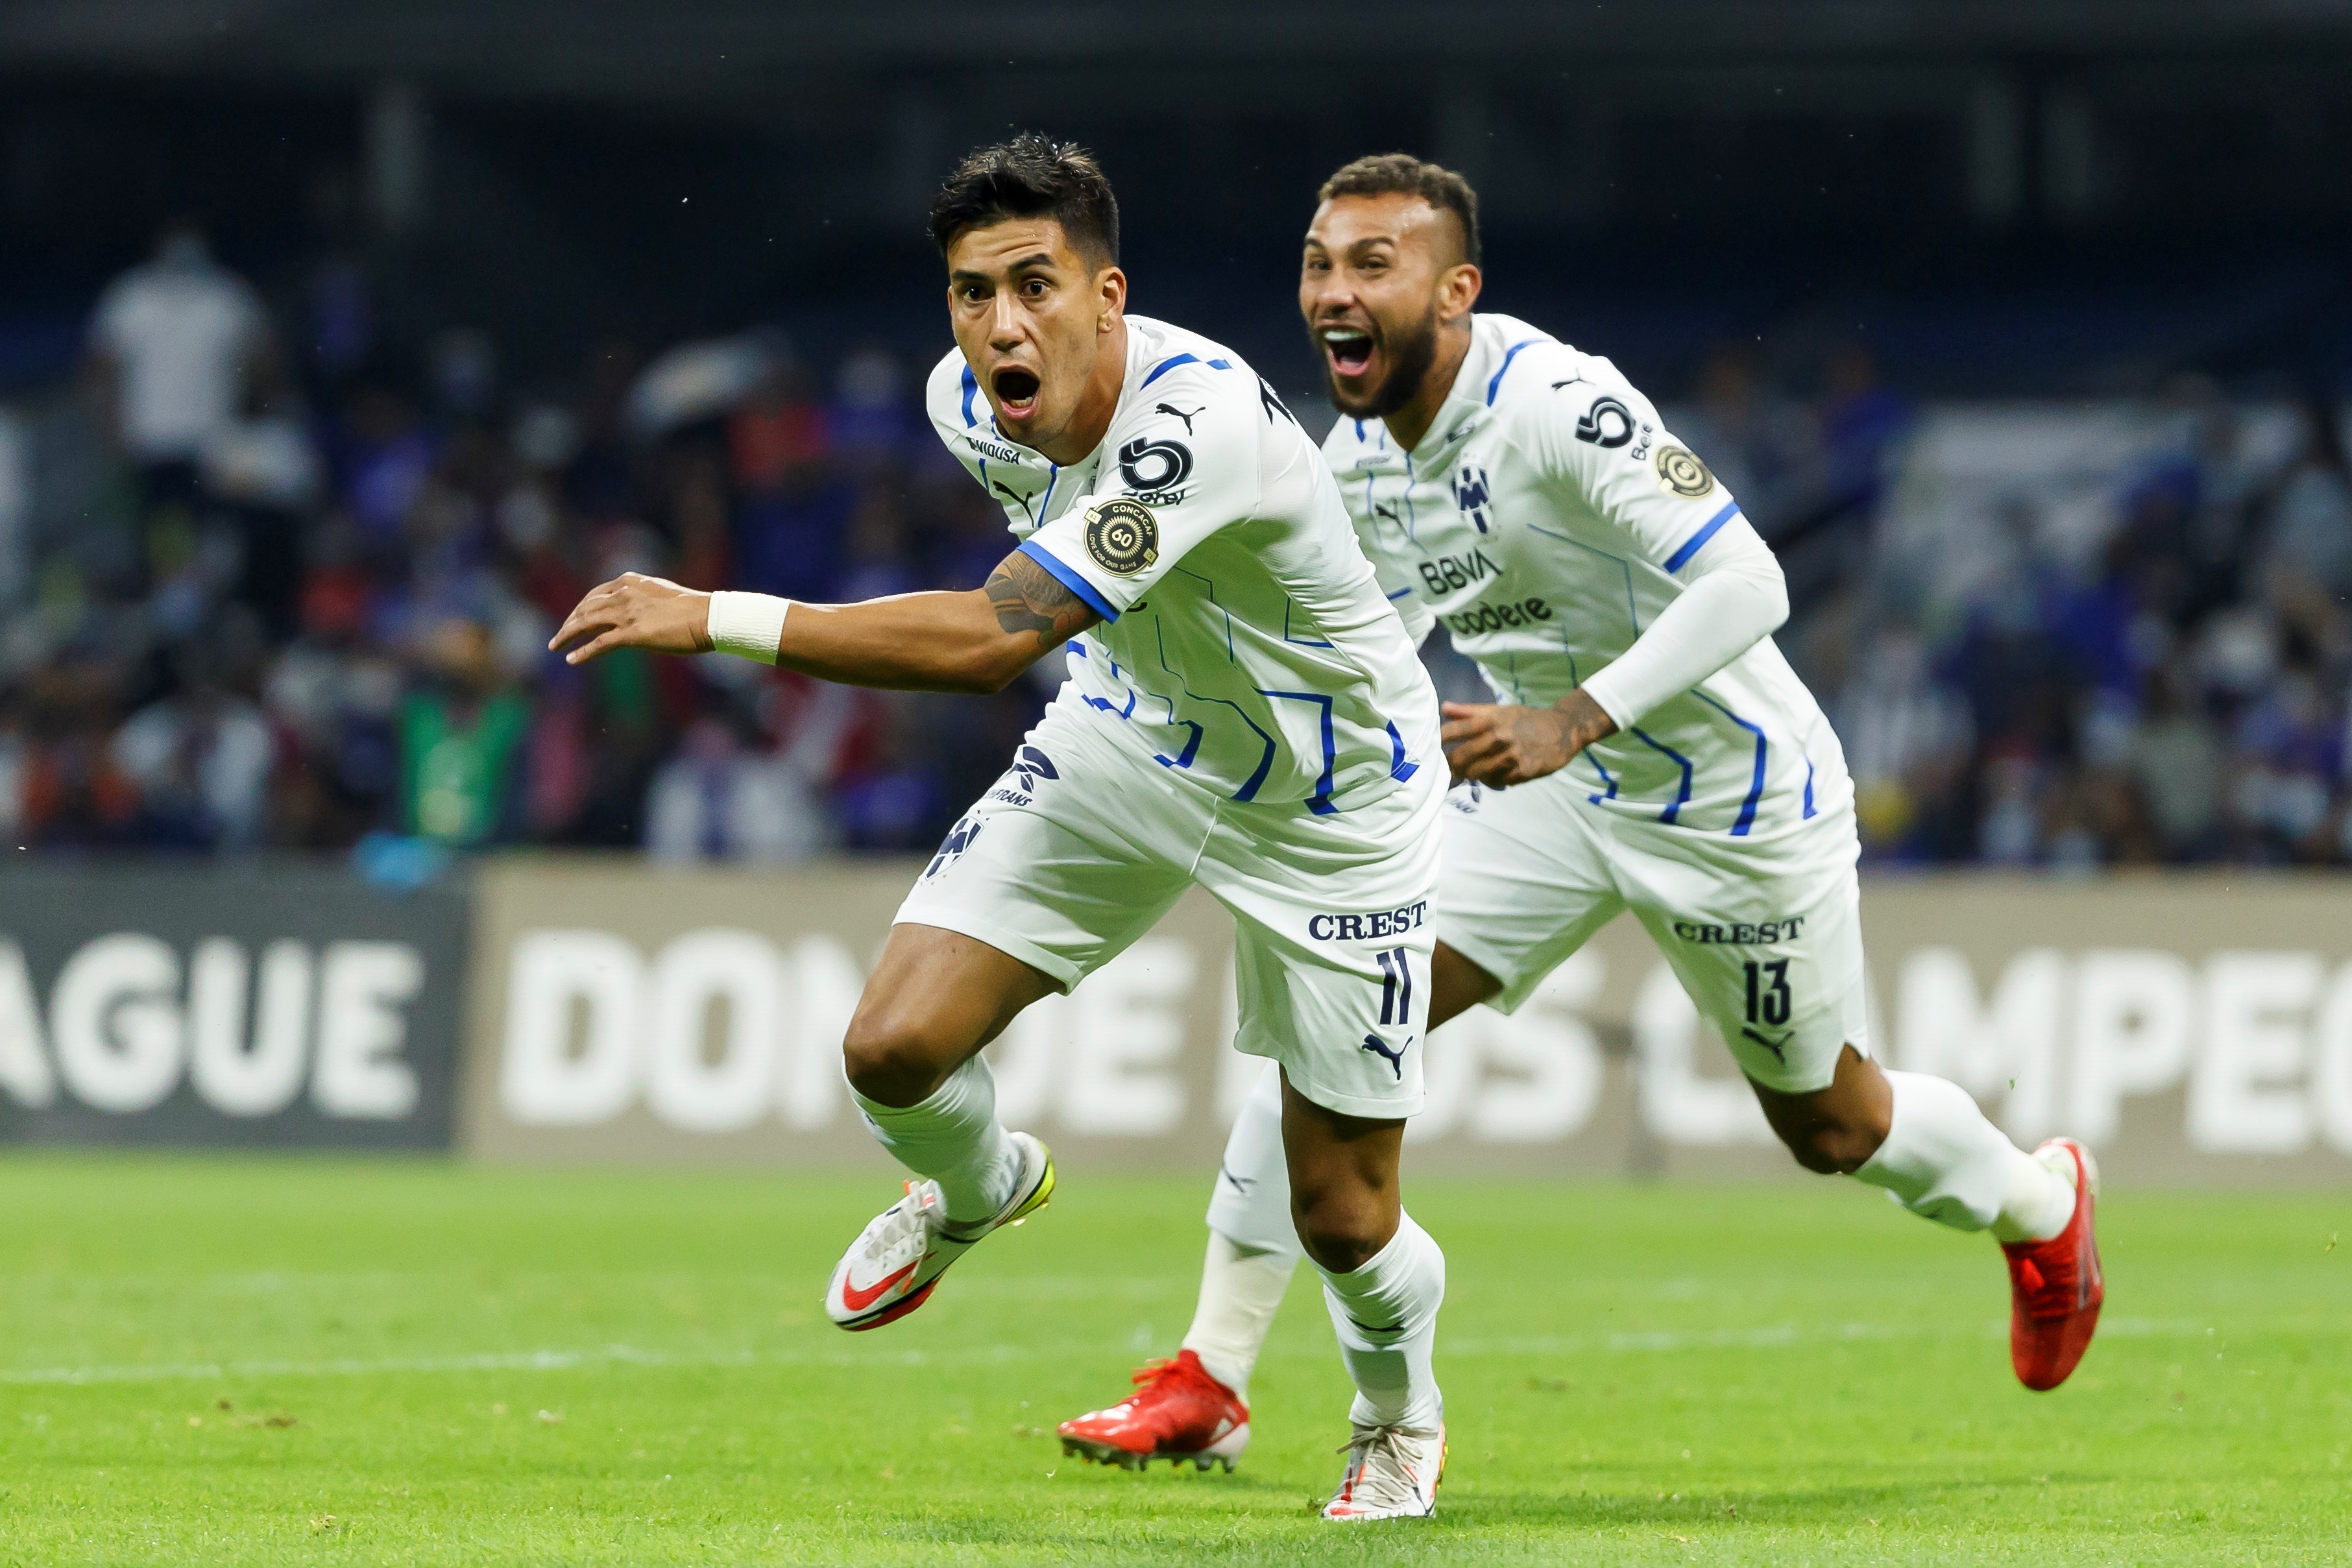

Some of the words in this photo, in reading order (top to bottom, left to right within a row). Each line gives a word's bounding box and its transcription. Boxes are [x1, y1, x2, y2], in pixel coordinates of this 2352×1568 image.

[1111, 528, 1133, 548] 60
[1112, 505, 1153, 537] CONCACAF
[1094, 549, 1106, 562] FOR
[1105, 559, 1119, 569] OUR
[1120, 561, 1137, 570] GAME
[1418, 545, 1504, 595] BBVA
[1309, 900, 1427, 941] CREST
[1673, 915, 1805, 946] CREST
[1376, 946, 1412, 1026] 11
[1743, 958, 1791, 1026] 13
